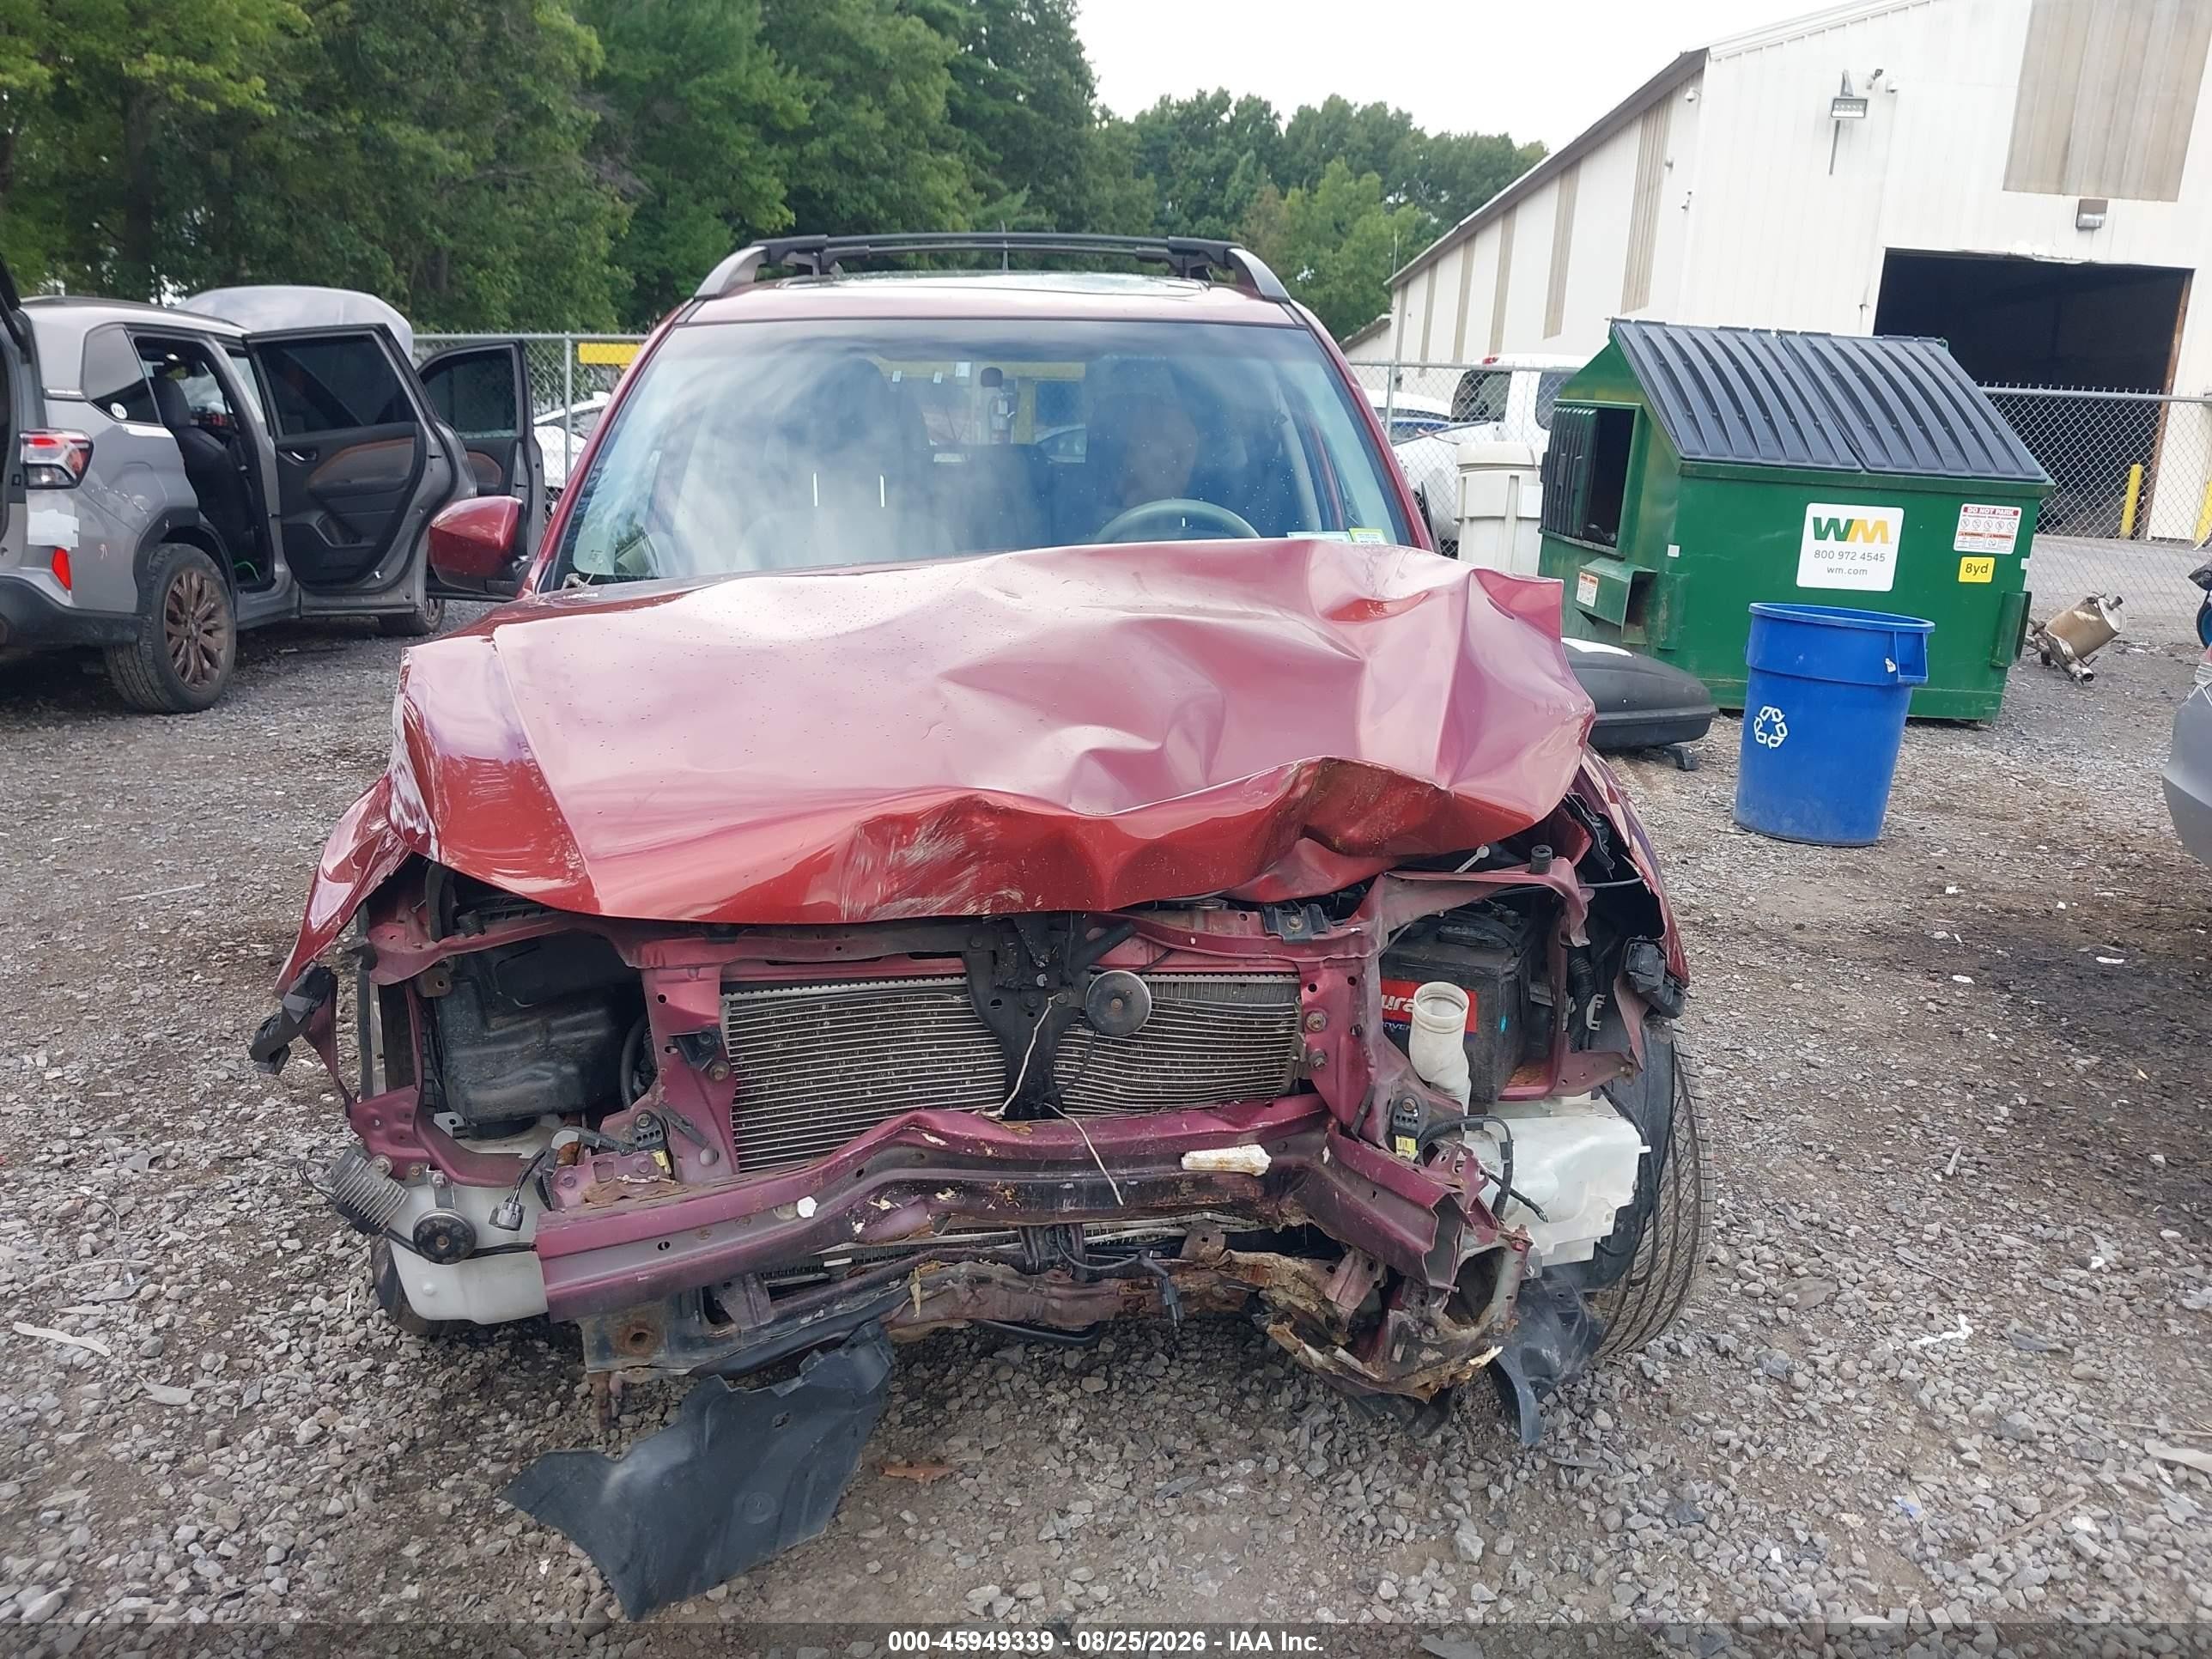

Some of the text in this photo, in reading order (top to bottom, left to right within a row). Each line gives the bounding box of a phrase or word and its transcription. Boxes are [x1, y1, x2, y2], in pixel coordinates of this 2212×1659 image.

[1813, 517, 1889, 544] WM
[1814, 550, 1887, 562] 800 972 4545
[1826, 567, 1868, 575] wm.com
[1965, 562, 1989, 576] 8yd
[1381, 994, 1415, 1012] ura
